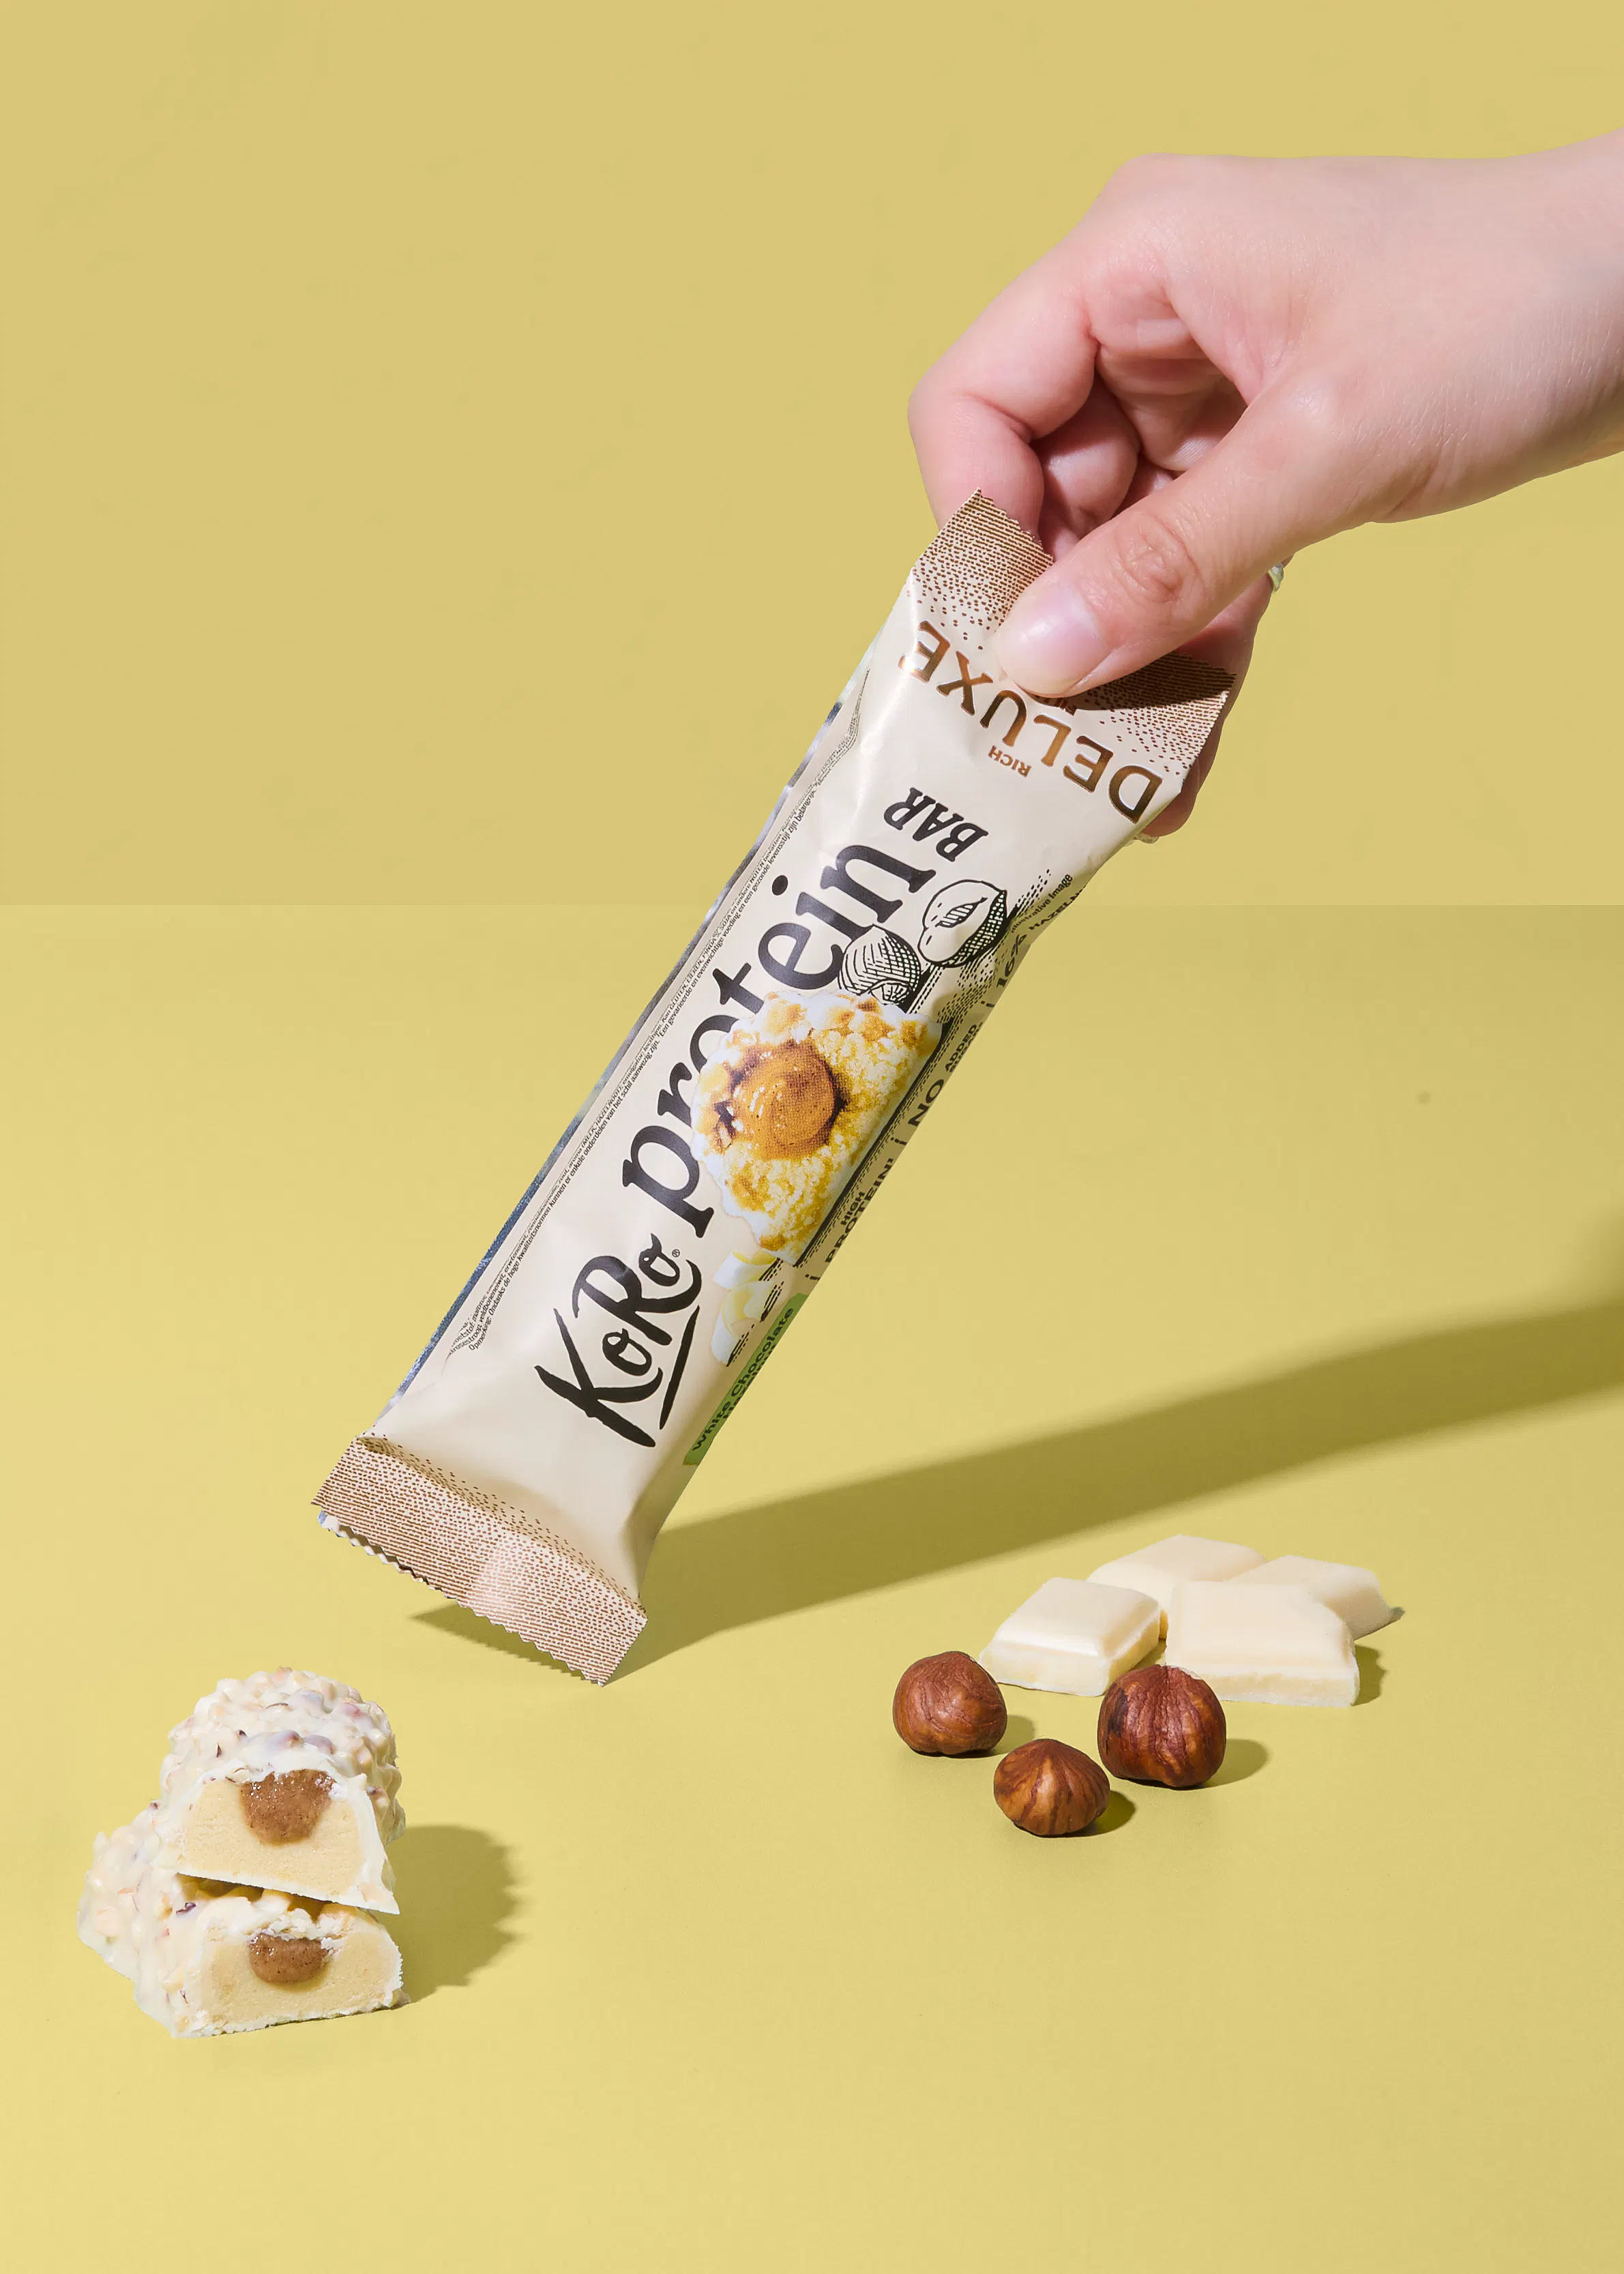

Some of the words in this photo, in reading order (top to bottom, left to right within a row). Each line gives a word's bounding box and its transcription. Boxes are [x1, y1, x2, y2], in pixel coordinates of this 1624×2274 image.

[898, 621, 1162, 824] DELUXE
[988, 745, 1032, 778] RICH
[884, 787, 988, 862] BAR
[1048, 874, 1073, 898] Image
[996, 934, 1026, 987] 16%
[487, 1286, 505, 1316] Ondanks
[503, 1278, 510, 1287] de
[507, 1260, 520, 1278] hoge
[516, 1206, 550, 1261] kwaliteitsnormen
[548, 1183, 567, 1207] kunnen
[564, 1175, 572, 1184] er
[569, 1154, 585, 1177] enkele
[582, 1119, 608, 1155] onderdelen
[605, 1107, 616, 1121] van
[612, 1095, 623, 1108] het
[620, 1080, 633, 1097] schil
[630, 1050, 652, 1082] aanwezig
[666, 986, 692, 1025] gevarieerde
[690, 977, 698, 988] en
[696, 936, 724, 978] evenwichtige
[722, 911, 740, 937] voeding
[737, 902, 745, 913] en
[743, 890, 754, 904] een
[751, 863, 770, 891] gezonde
[767, 831, 790, 864] levensstijl
[786, 820, 798, 833] zijn
[944, 1024, 975, 1071] ADDED
[908, 1079, 944, 1126] NO
[840, 1192, 866, 1224] HIGH
[692, 1400, 730, 1450] White
[732, 1308, 793, 1397] Chocolate
